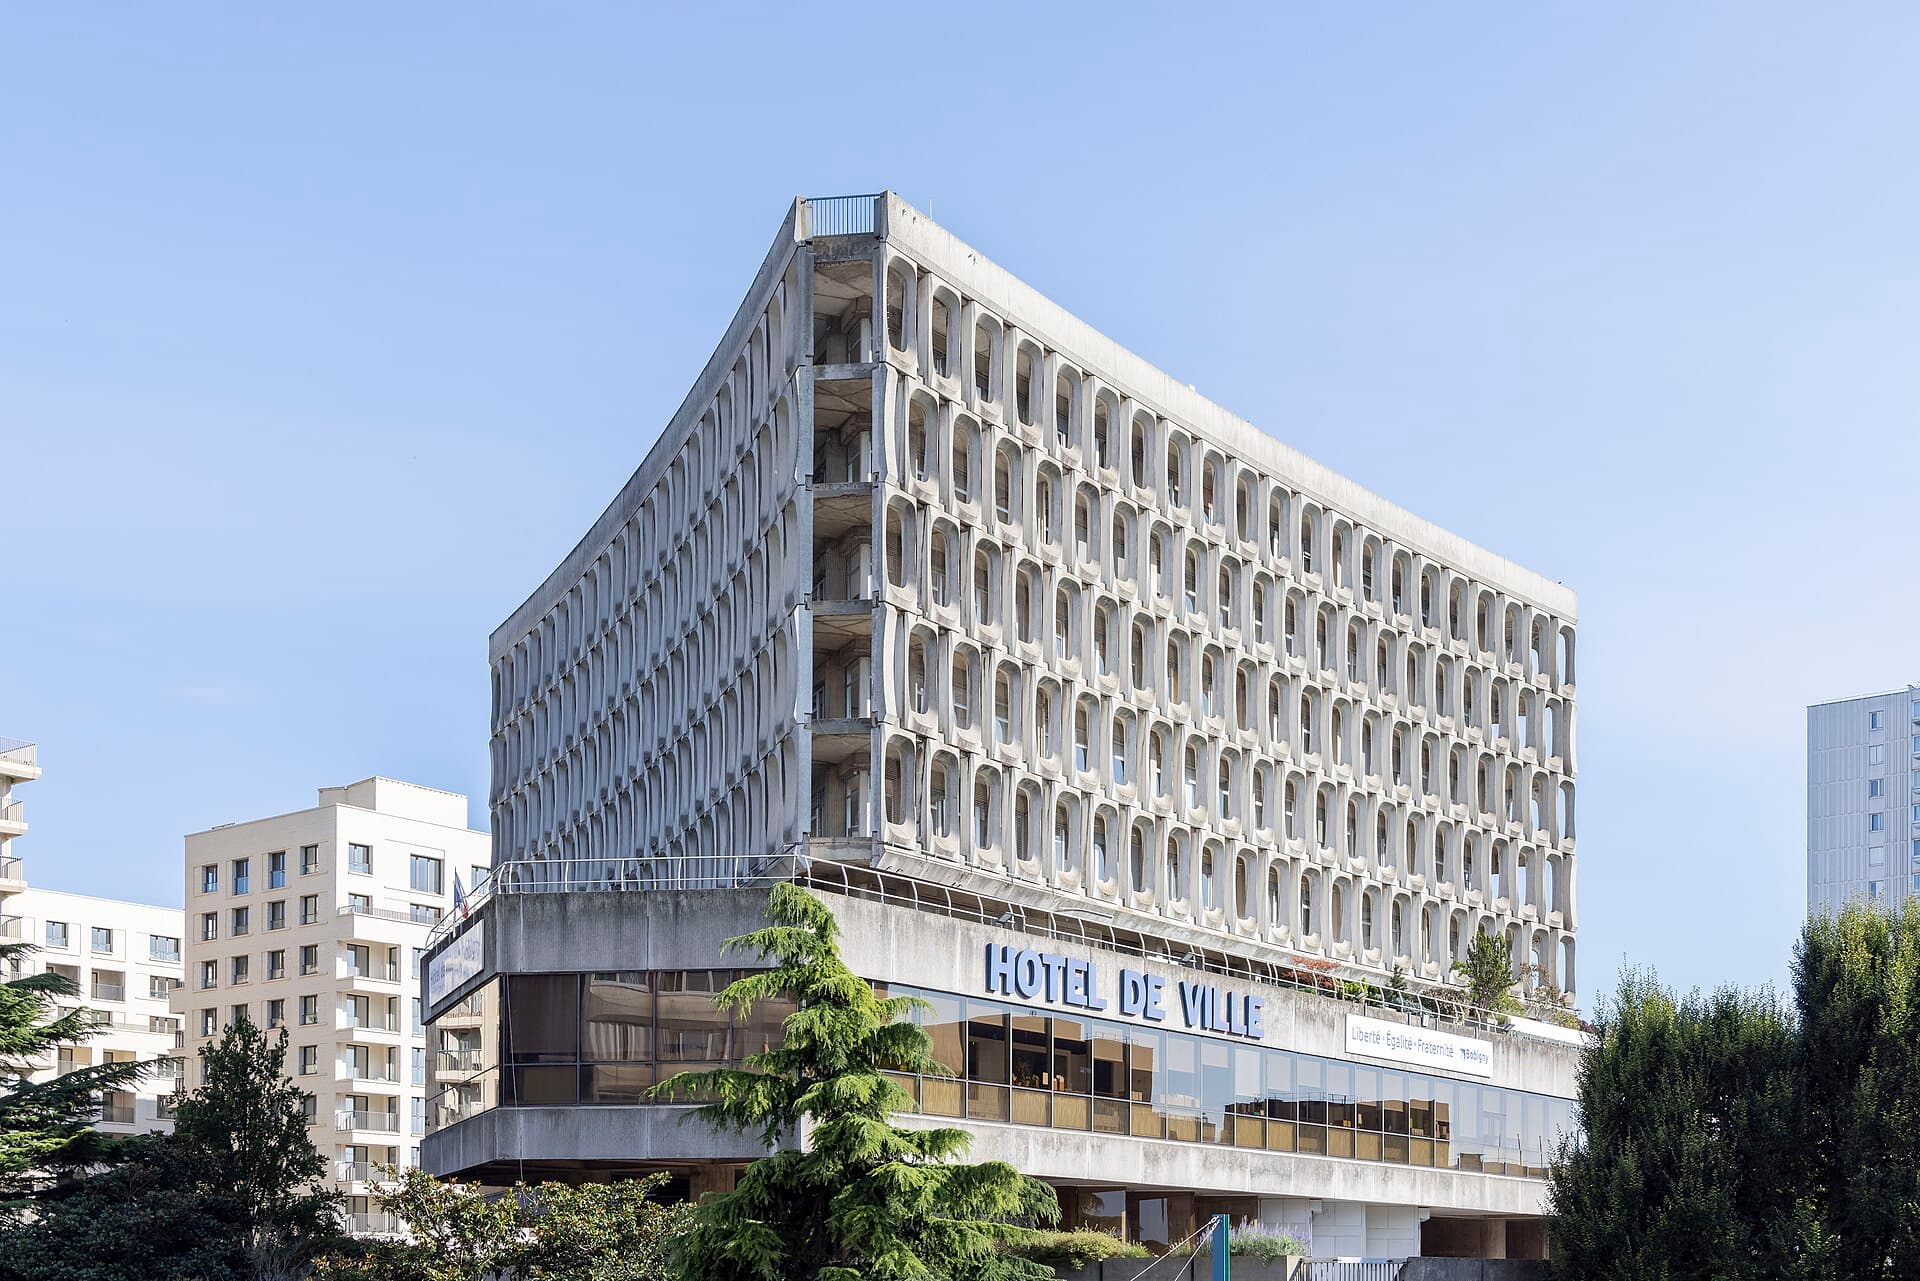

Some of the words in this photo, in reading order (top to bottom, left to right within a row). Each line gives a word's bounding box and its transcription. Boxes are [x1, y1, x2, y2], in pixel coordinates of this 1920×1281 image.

[986, 943, 1107, 1011] HOTEL
[1120, 969, 1165, 1022] DE
[1179, 981, 1265, 1040] VILLE
[1352, 1027, 1381, 1044] Liberté
[1386, 1030, 1413, 1050] Égalité
[1417, 1039, 1454, 1058] Fraternité
